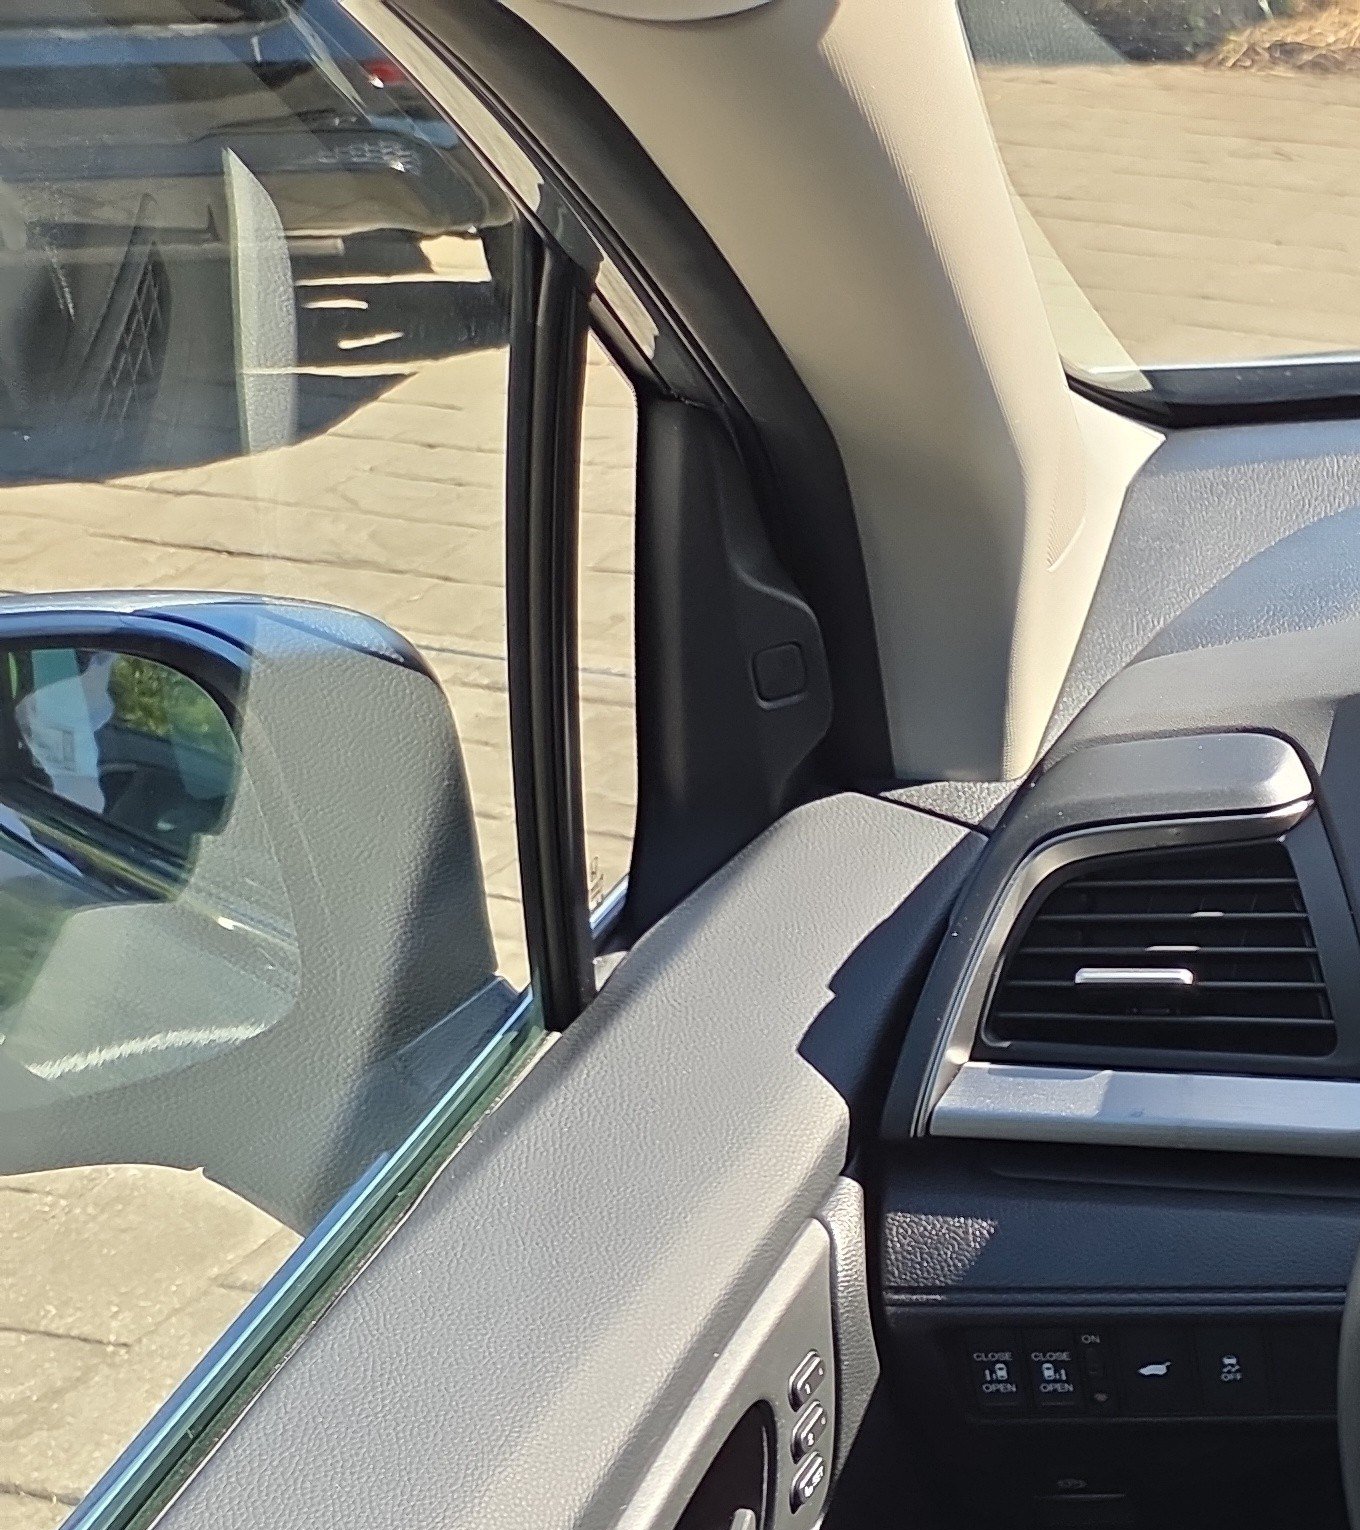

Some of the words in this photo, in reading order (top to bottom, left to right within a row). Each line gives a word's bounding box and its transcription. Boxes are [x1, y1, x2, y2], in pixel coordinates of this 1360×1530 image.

[1081, 1334, 1100, 1344] ON
[973, 1352, 1012, 1362] CLOSE
[1031, 1352, 1071, 1362] CLOSE
[982, 1383, 1017, 1393] OPEN
[1040, 1383, 1074, 1393] OPEN
